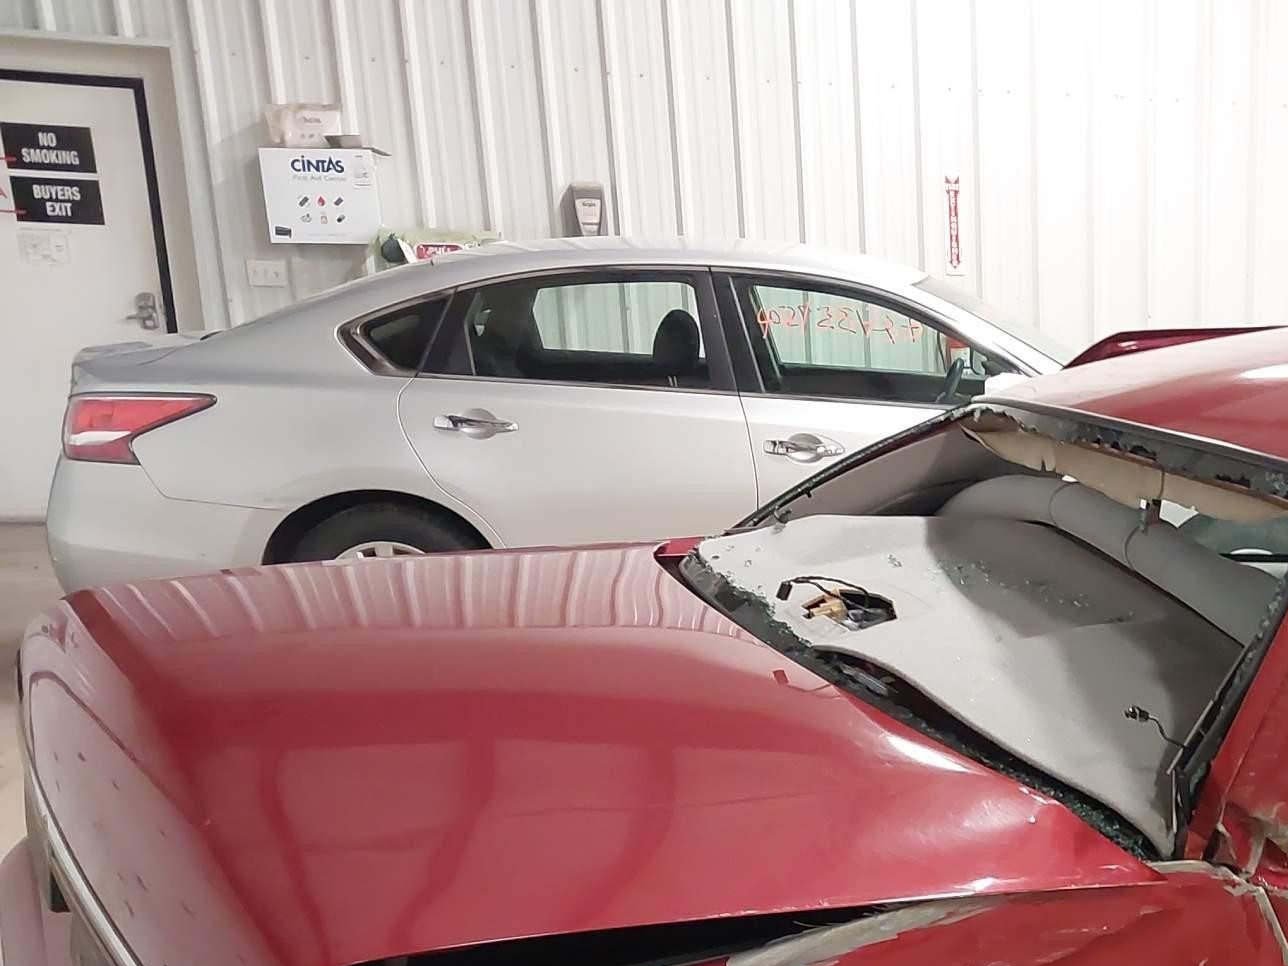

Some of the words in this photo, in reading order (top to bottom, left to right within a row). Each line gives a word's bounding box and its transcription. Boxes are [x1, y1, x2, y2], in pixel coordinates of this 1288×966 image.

[38, 132, 57, 147] NO
[21, 148, 80, 165] SMOKING
[32, 184, 81, 200] BUYERS
[45, 201, 72, 216] EXIT
